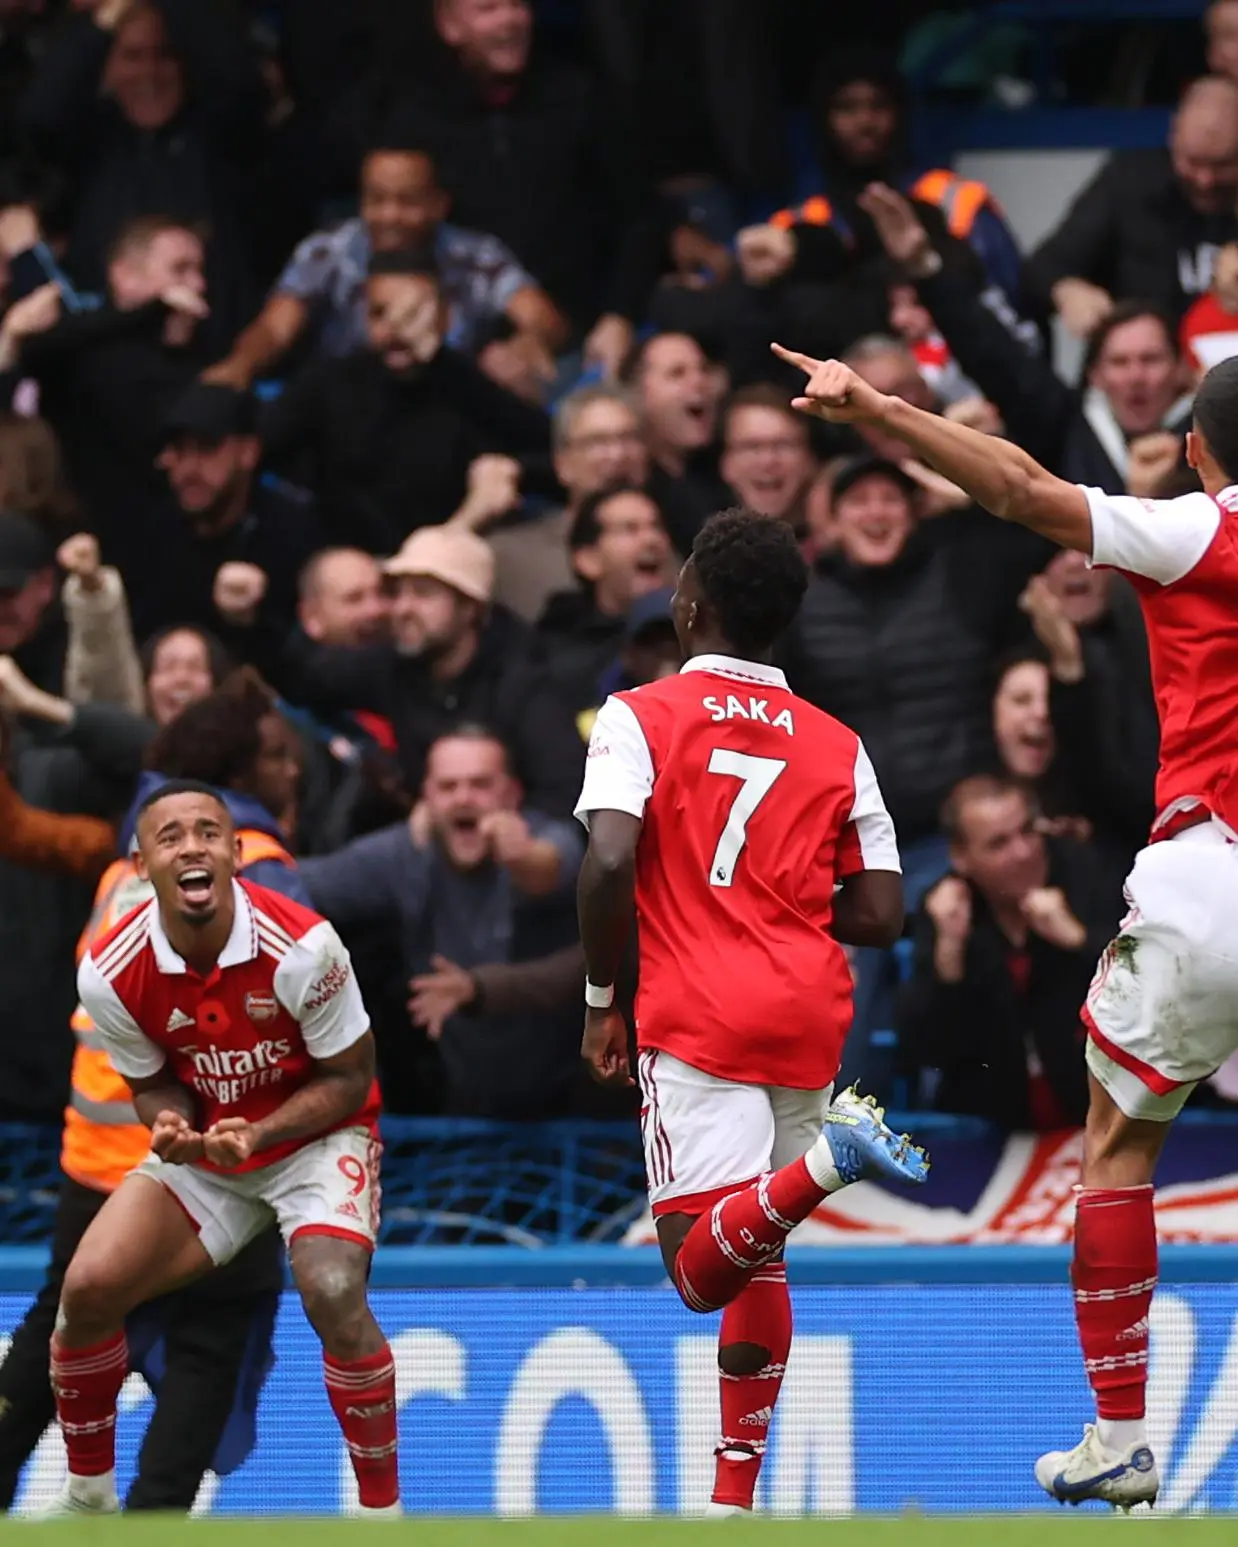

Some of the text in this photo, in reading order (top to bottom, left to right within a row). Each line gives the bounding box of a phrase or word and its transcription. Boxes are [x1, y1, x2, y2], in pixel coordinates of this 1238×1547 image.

[702, 695, 795, 736] SAKA
[707, 748, 788, 887] 7
[218, 1068, 283, 1104] BETTER
[336, 1154, 366, 1197] 9
